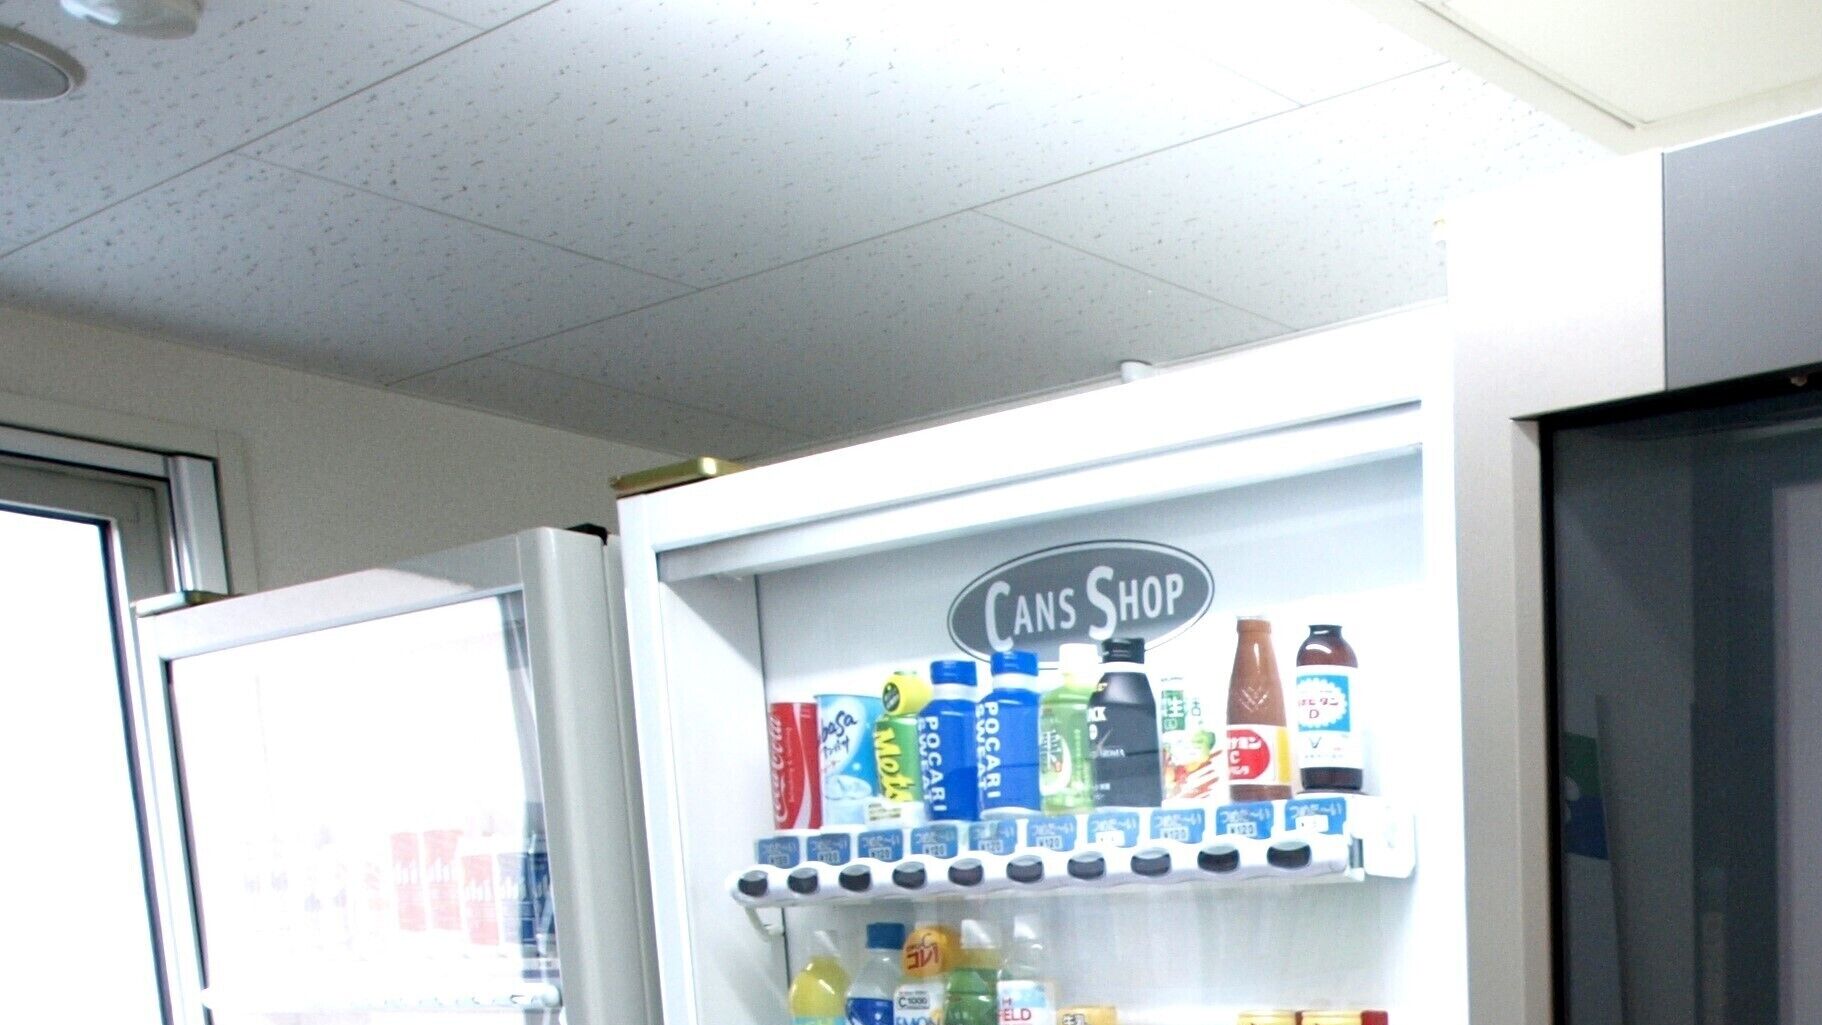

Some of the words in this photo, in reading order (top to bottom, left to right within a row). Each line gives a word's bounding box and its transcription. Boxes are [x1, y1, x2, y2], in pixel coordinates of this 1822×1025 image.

[983, 581, 1076, 652] CANS
[1086, 565, 1185, 641] SHOP
[924, 716, 947, 811] POCARI
[984, 702, 1001, 798] POCARI
